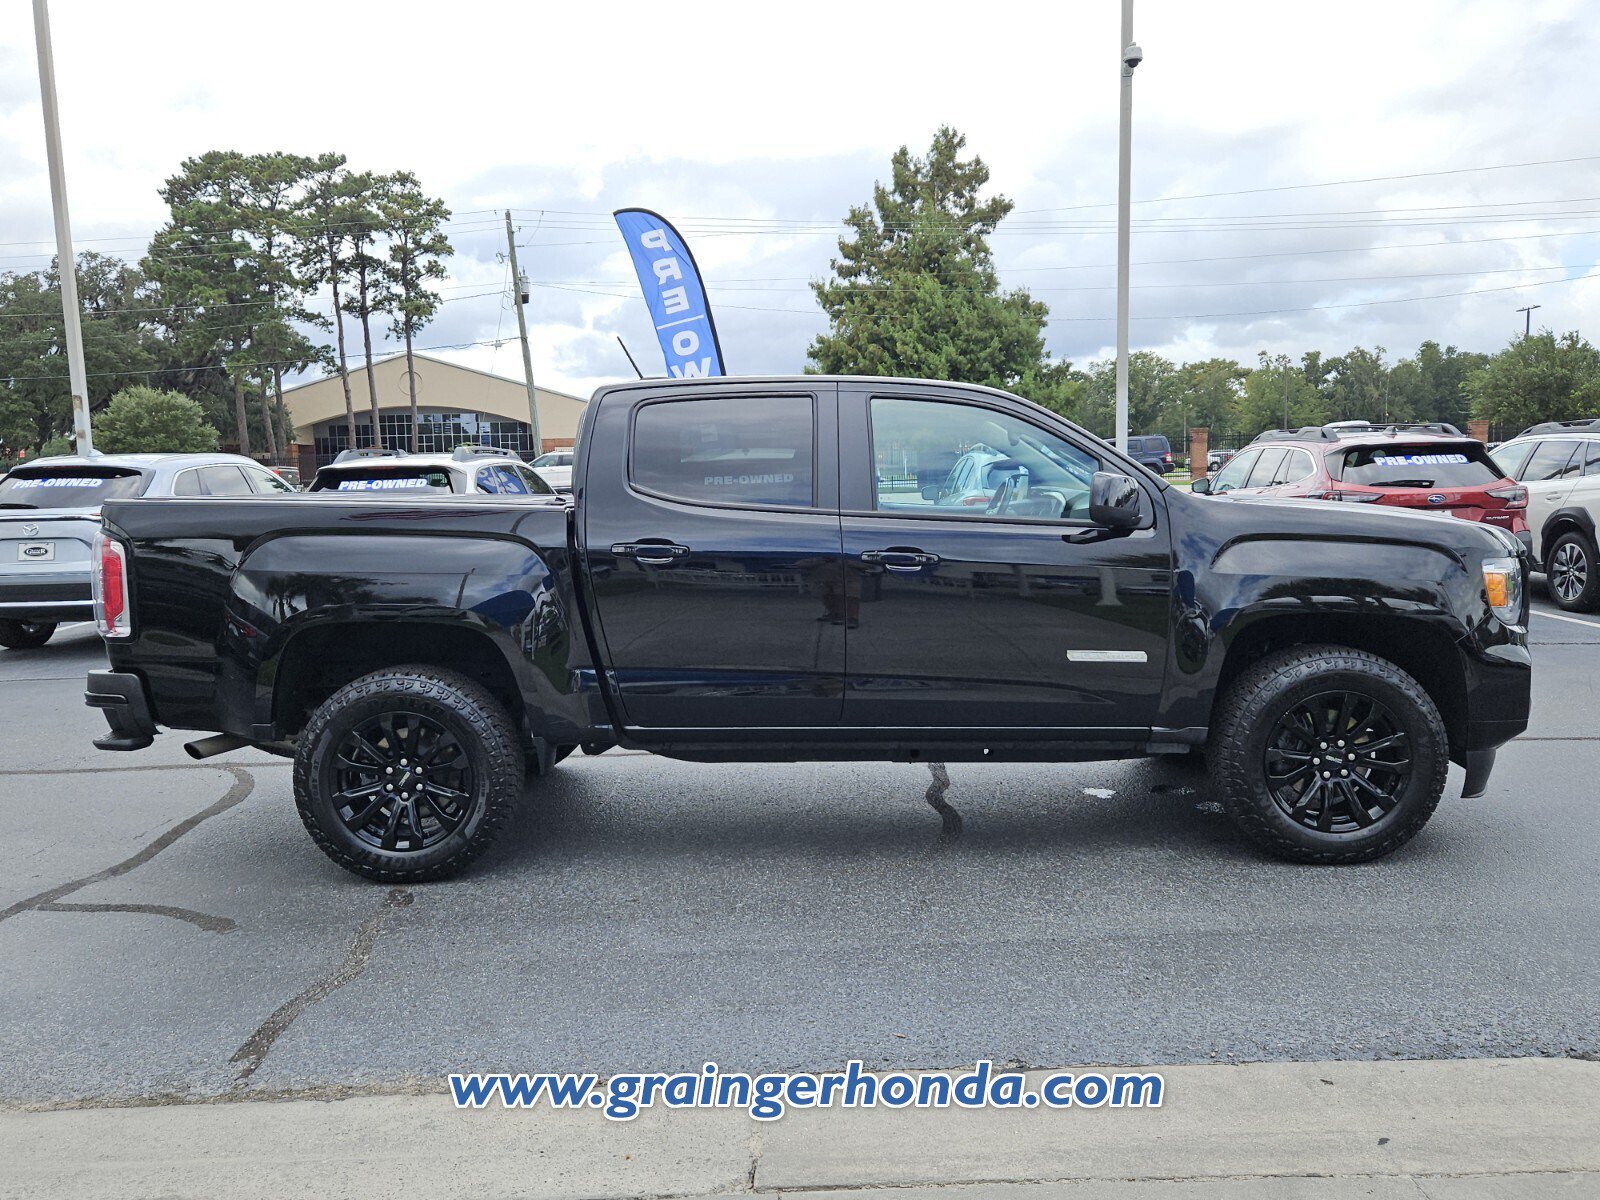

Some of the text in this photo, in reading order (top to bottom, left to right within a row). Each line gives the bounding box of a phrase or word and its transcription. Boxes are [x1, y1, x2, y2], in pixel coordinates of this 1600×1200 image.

[1373, 454, 1468, 466] PRE-OWNED
[12, 478, 103, 489] PRE-OWNED
[338, 479, 428, 490] PRE-OWNED
[704, 474, 794, 485] PRE-OWNED
